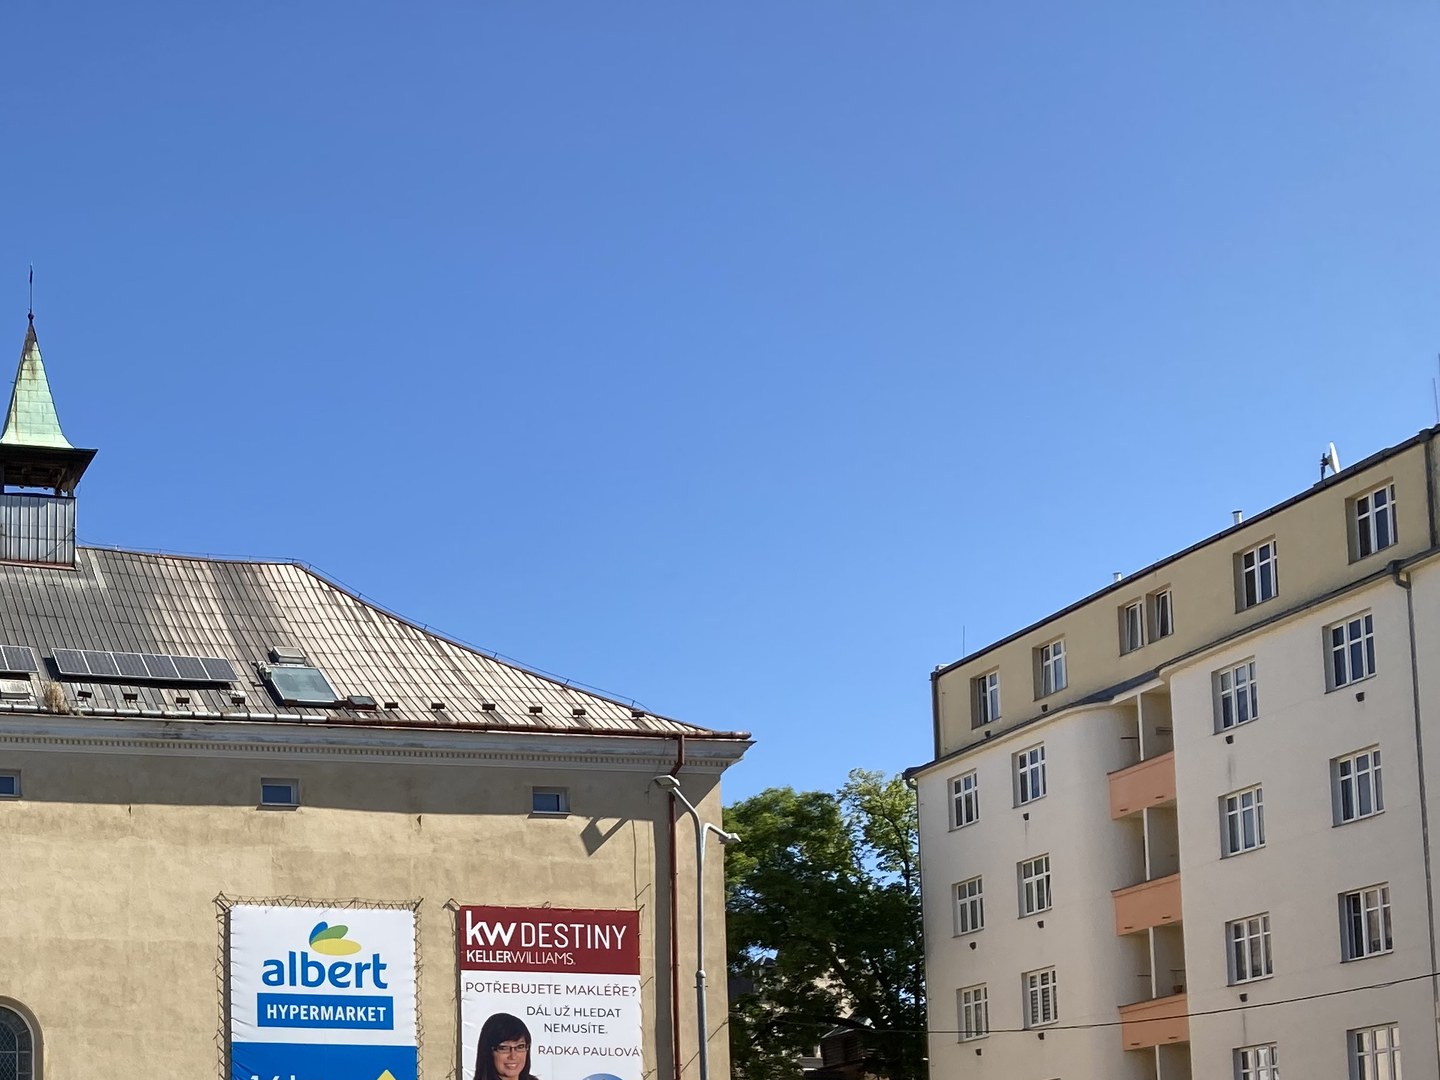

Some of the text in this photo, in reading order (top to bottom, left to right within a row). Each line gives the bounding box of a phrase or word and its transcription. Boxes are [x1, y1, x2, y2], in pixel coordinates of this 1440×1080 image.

[521, 922, 627, 950] DESTINY
[261, 950, 388, 989] albert
[465, 980, 637, 997] POTŘEBUJETE MAKLÉŘE?
[266, 1004, 387, 1022] HYPERMARKET
[526, 1004, 622, 1018] DÁL UŽ HLEDAT
[544, 1022, 608, 1034] NEMUSÍTE.
[538, 1044, 640, 1057] RADKA PAULOVÁ
